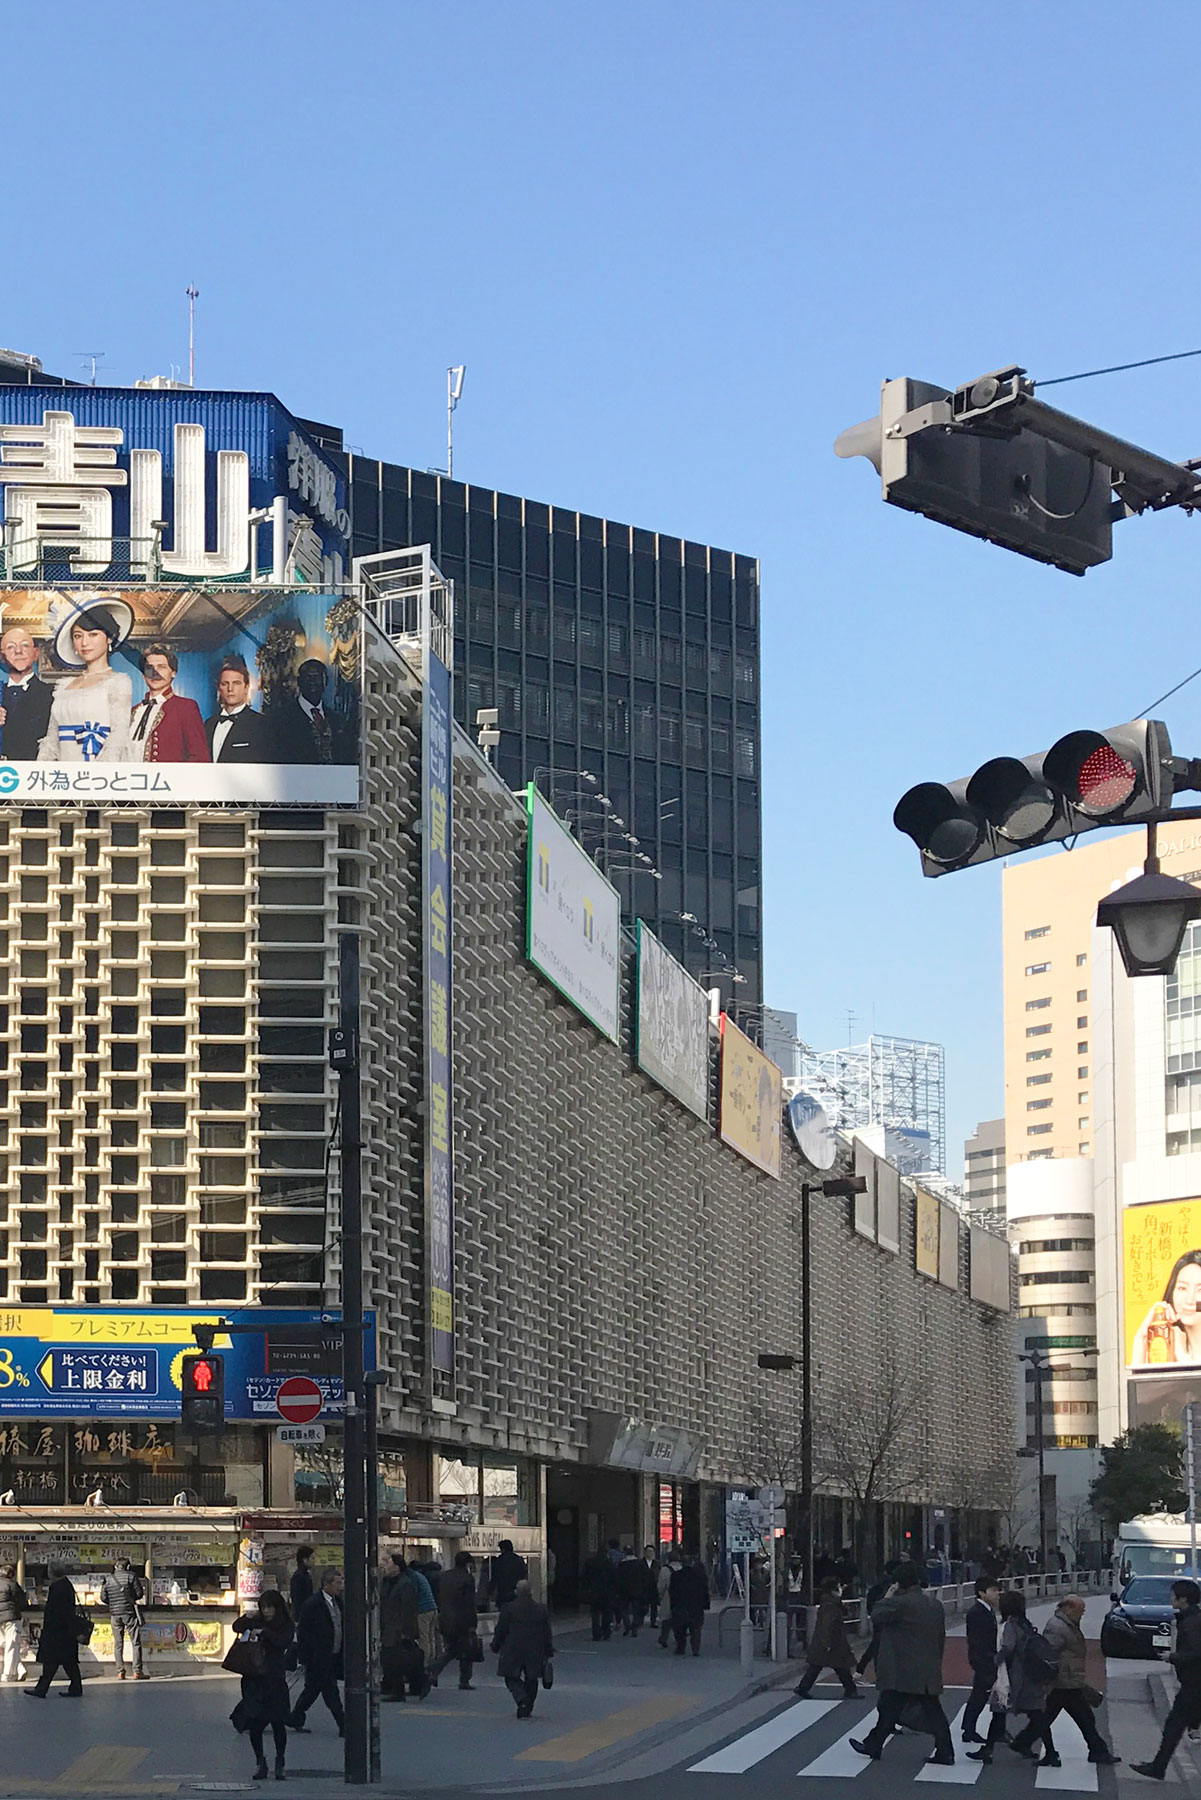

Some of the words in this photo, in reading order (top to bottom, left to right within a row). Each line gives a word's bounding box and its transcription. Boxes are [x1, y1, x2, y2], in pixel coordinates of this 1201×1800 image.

[27, 769, 172, 791] 外為どっとコム
[1159, 1220, 1173, 1261] 新橋の
[1144, 1213, 1159, 1291] 角ハイボールが
[70, 1320, 193, 1337] プレミアムコー
[61, 1369, 147, 1390] 上限金利
[280, 1429, 321, 1441] 自転車を除く
